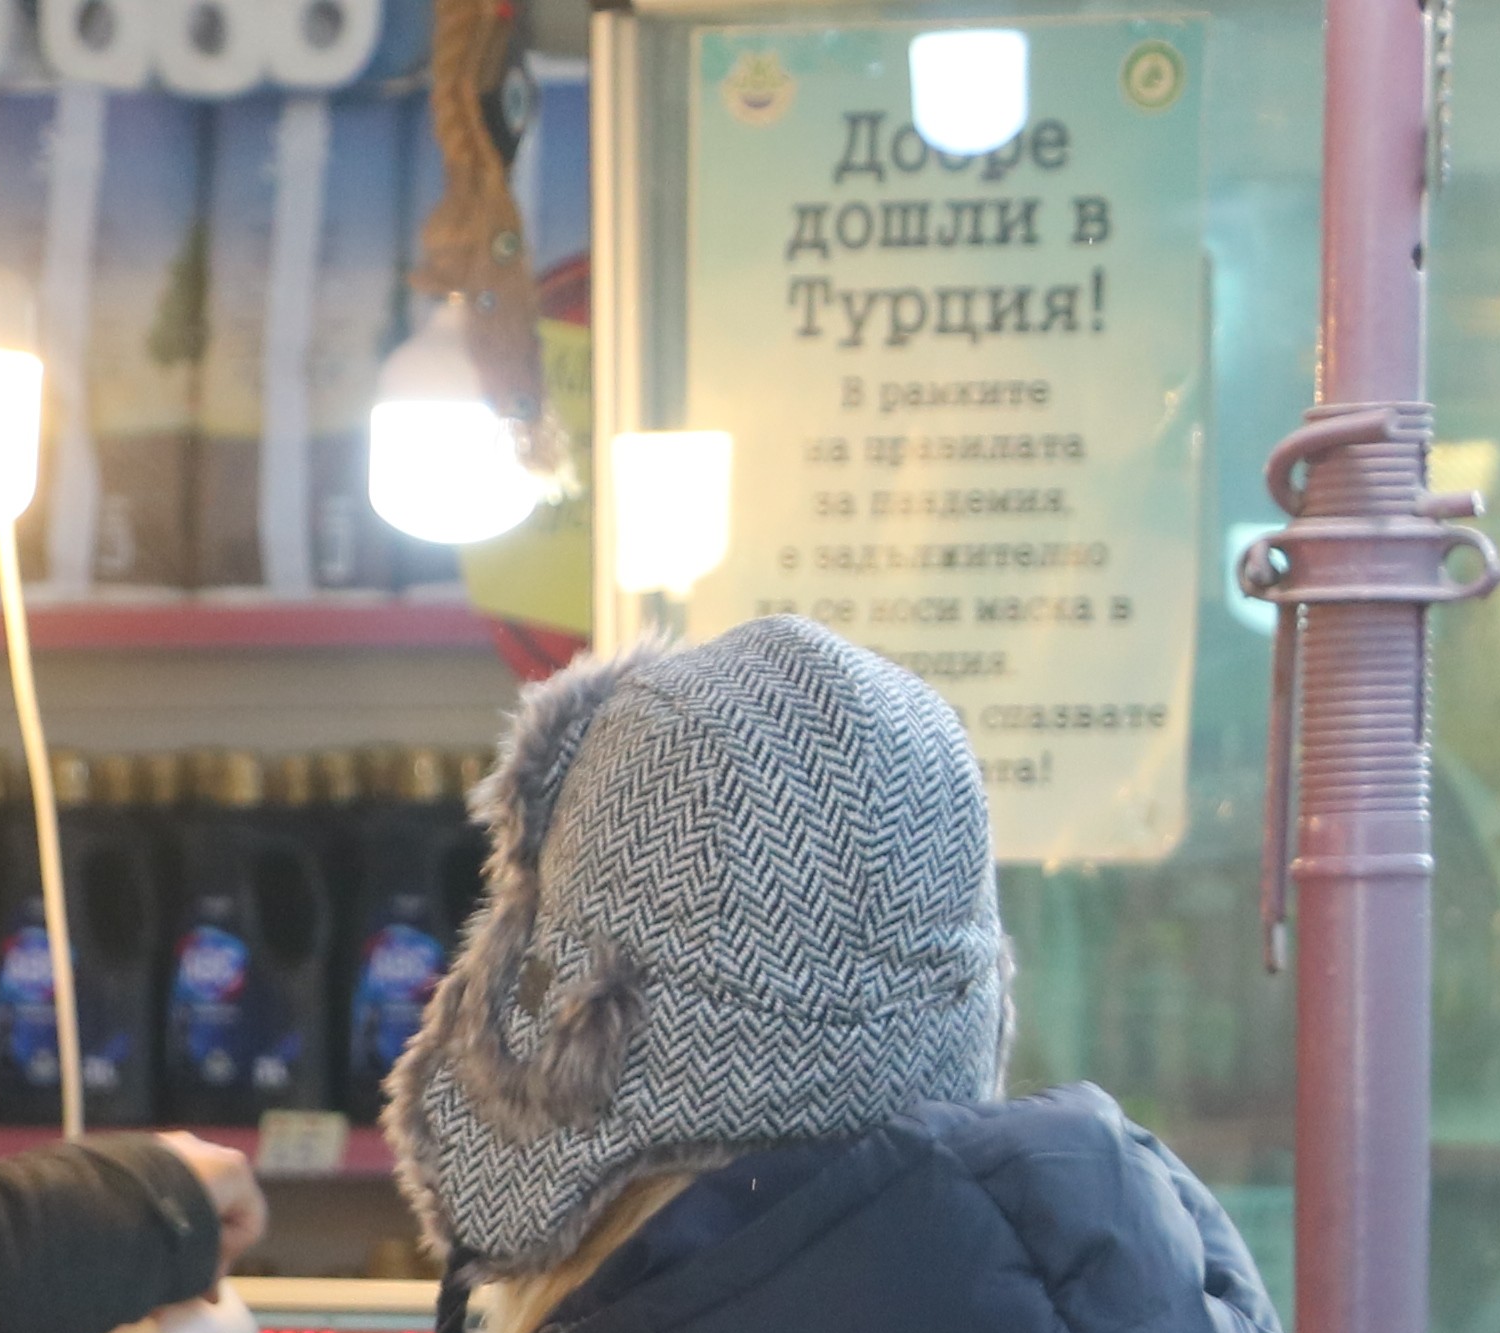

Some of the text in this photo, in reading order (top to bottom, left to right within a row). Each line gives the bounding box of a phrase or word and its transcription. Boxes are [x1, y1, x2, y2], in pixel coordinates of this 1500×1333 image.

[786, 196, 1109, 260] дошли в
[788, 267, 1104, 347] Турция!
[880, 378, 1051, 412] рамките
